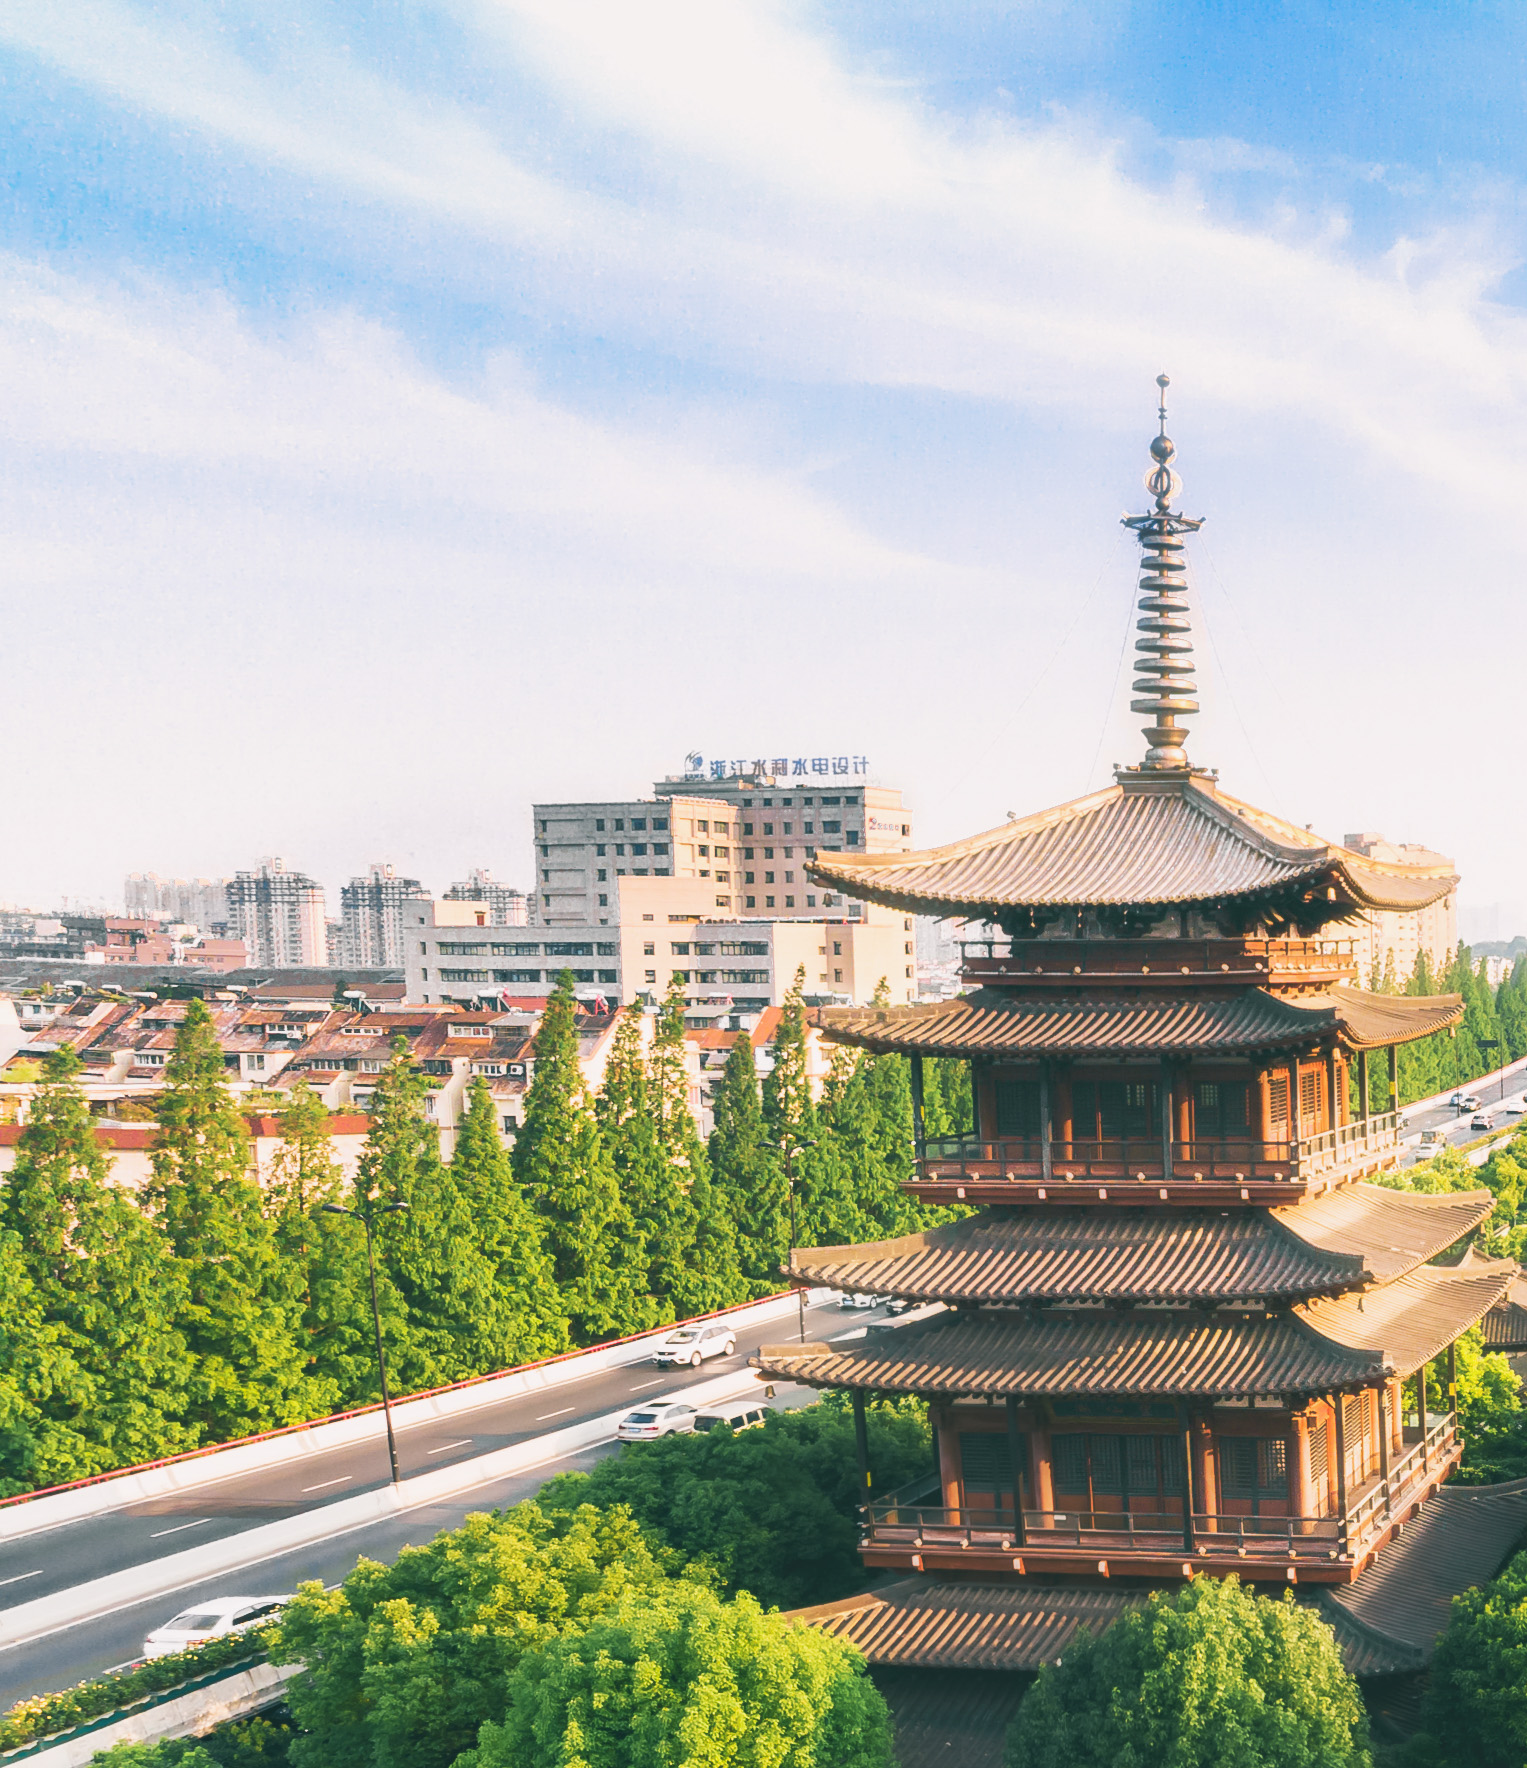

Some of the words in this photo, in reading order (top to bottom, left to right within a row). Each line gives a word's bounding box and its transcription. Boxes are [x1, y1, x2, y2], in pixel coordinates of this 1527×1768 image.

[709, 756, 869, 777] 浙江水利水电设计
